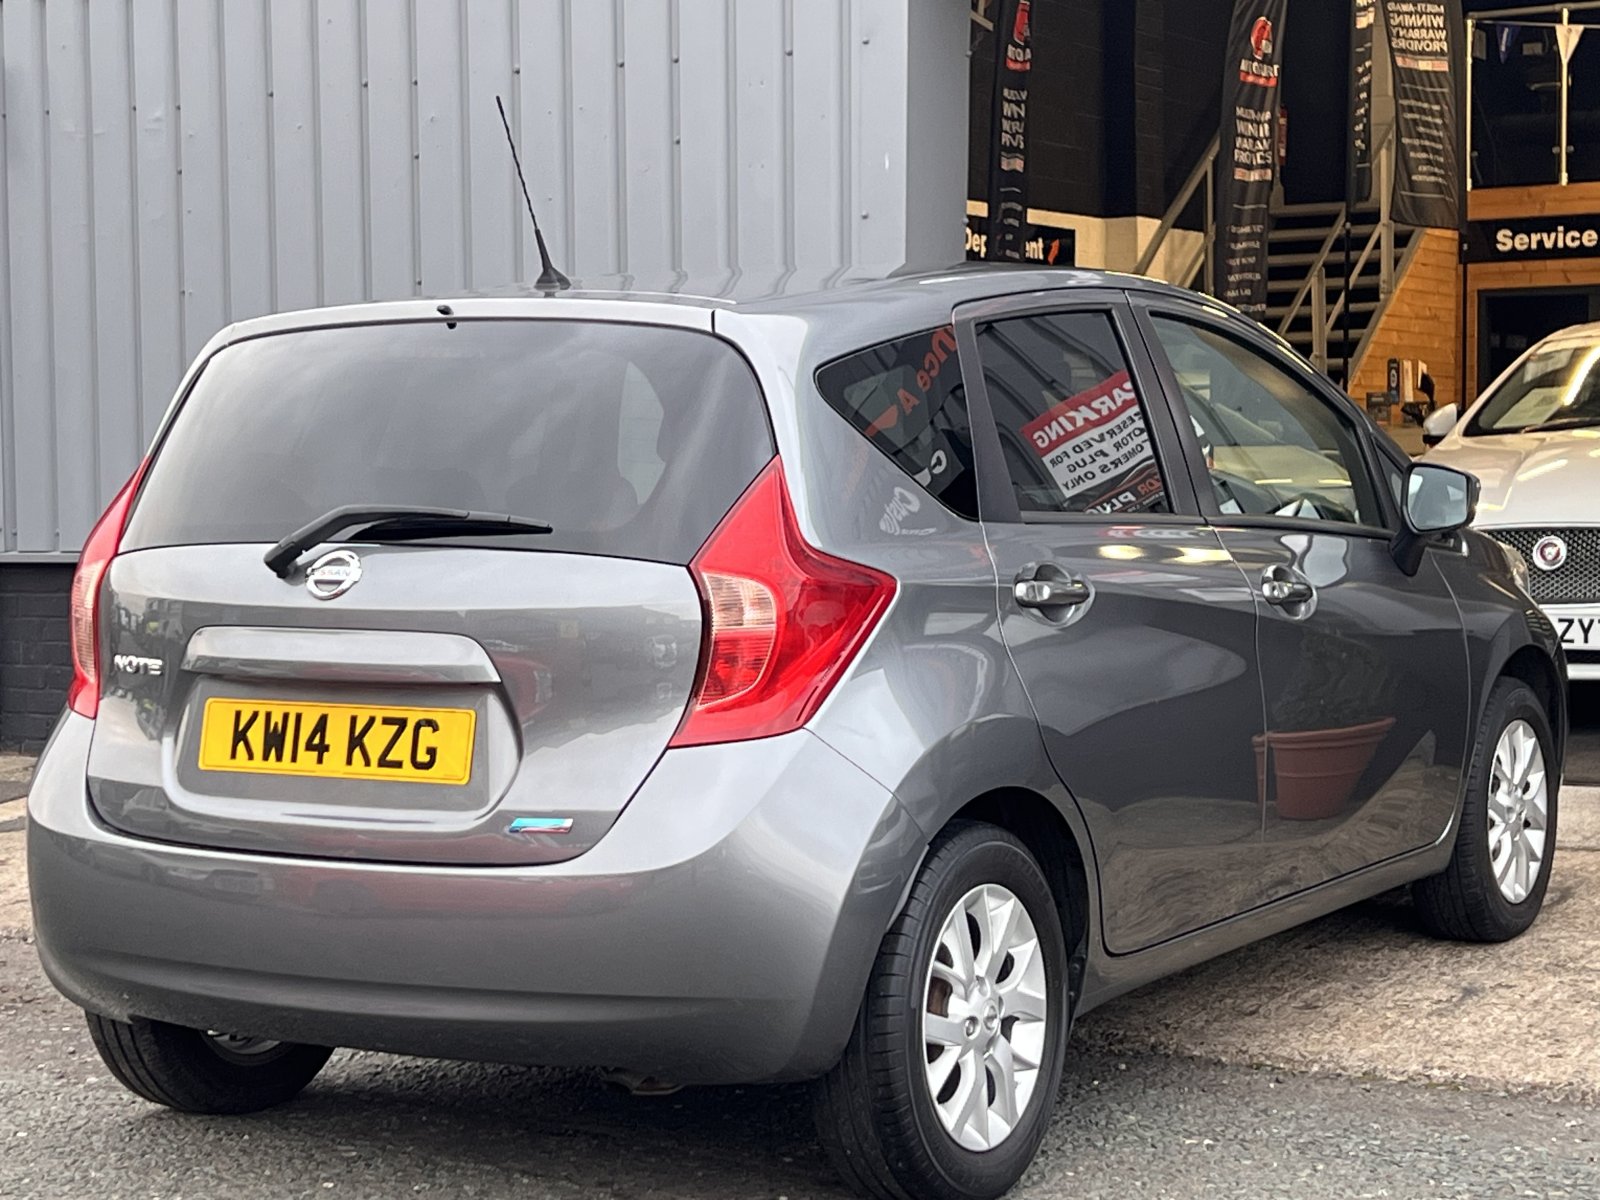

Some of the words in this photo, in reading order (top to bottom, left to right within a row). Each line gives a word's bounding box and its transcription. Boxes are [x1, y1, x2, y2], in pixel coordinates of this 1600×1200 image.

[1496, 226, 1598, 252] Service
[1558, 619, 1600, 643] ZY
[114, 654, 163, 675] NOTE
[230, 710, 330, 765] KW14
[346, 715, 439, 770] KZG
